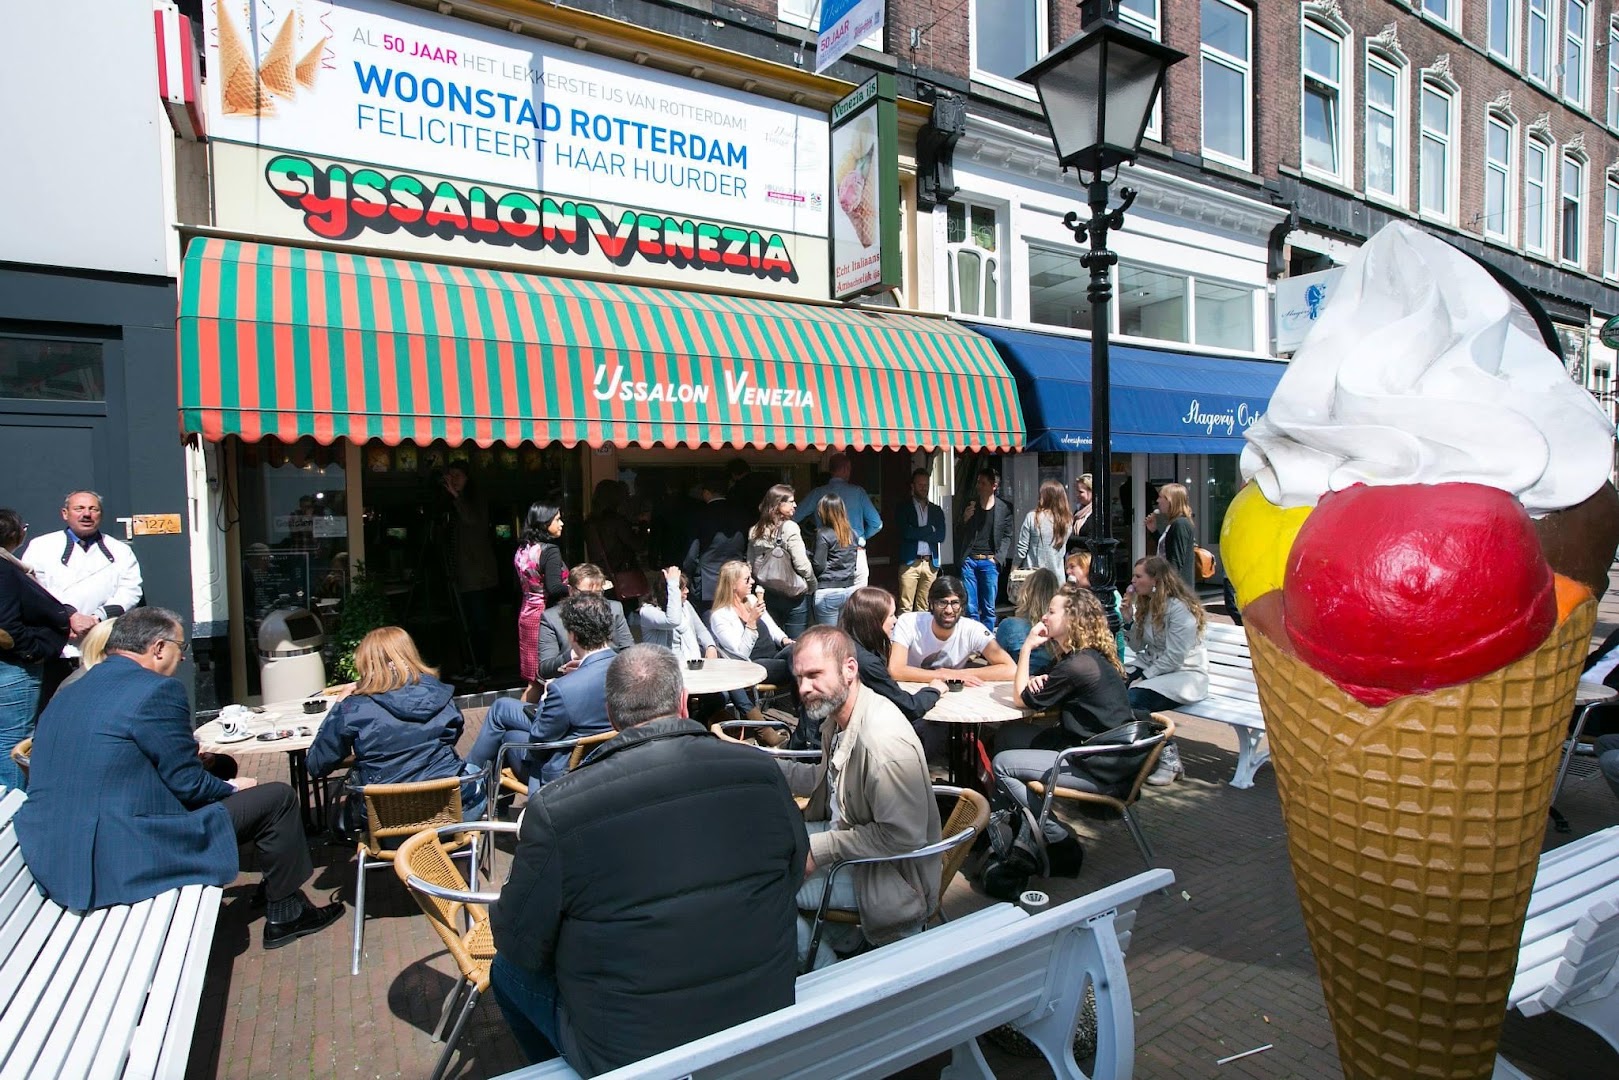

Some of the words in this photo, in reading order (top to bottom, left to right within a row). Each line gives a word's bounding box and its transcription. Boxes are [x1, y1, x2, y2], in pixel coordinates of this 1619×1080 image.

[820, 37, 830, 51] 50
[831, 20, 850, 45] JAAR
[353, 27, 378, 47] AL
[383, 34, 405, 53] 50
[410, 41, 458, 66] JAAR
[463, 52, 497, 74] HET
[502, 62, 598, 98] LEKKERSTE
[602, 86, 623, 103] IJS
[626, 91, 655, 111] VAN
[660, 99, 747, 132] ROTTERDAM!
[353, 61, 561, 132] WOONSTAD
[571, 108, 747, 170] ROTTERDAM
[834, 91, 864, 118] Venezia
[866, 82, 876, 98] ijs
[358, 104, 547, 162] FELICITEERT
[556, 143, 626, 177] HAAR
[634, 158, 747, 199] HUURDER
[577, 203, 797, 283] VENEZIA
[836, 264, 850, 278] Echt
[724, 370, 815, 408] VENEZIA
[1182, 399, 1235, 436] Slagerij
